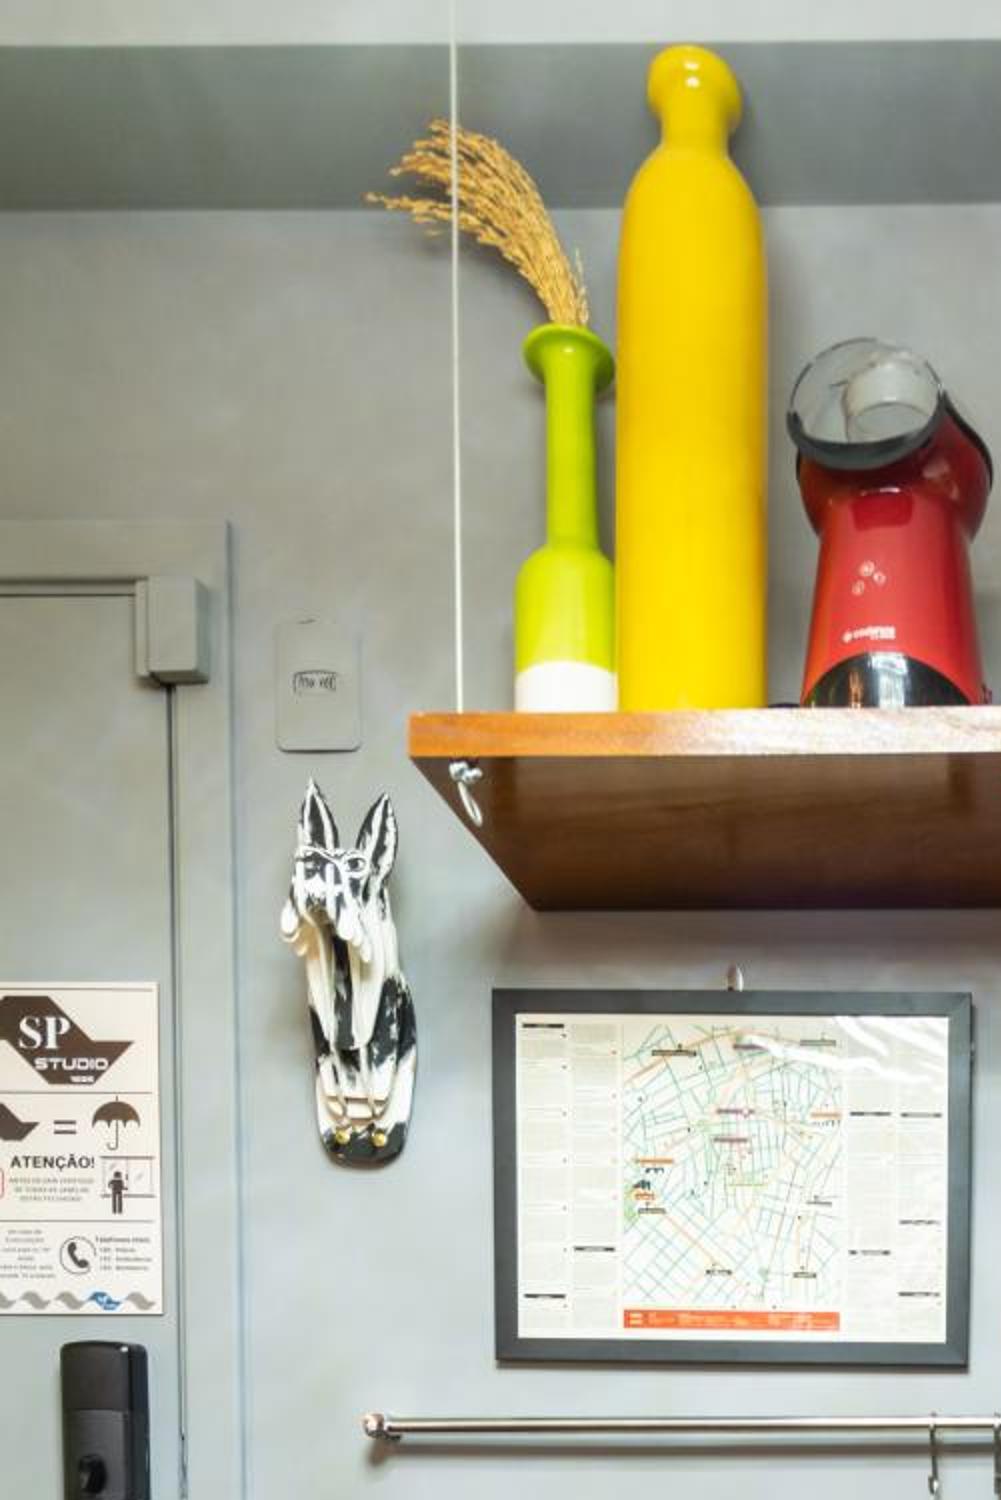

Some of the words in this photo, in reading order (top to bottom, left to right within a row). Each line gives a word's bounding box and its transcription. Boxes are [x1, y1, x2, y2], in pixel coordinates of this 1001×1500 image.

[18, 1015, 71, 1049] SP
[34, 1057, 109, 1071] STUDIO
[10, 1154, 96, 1172] ATENÇÃO!
